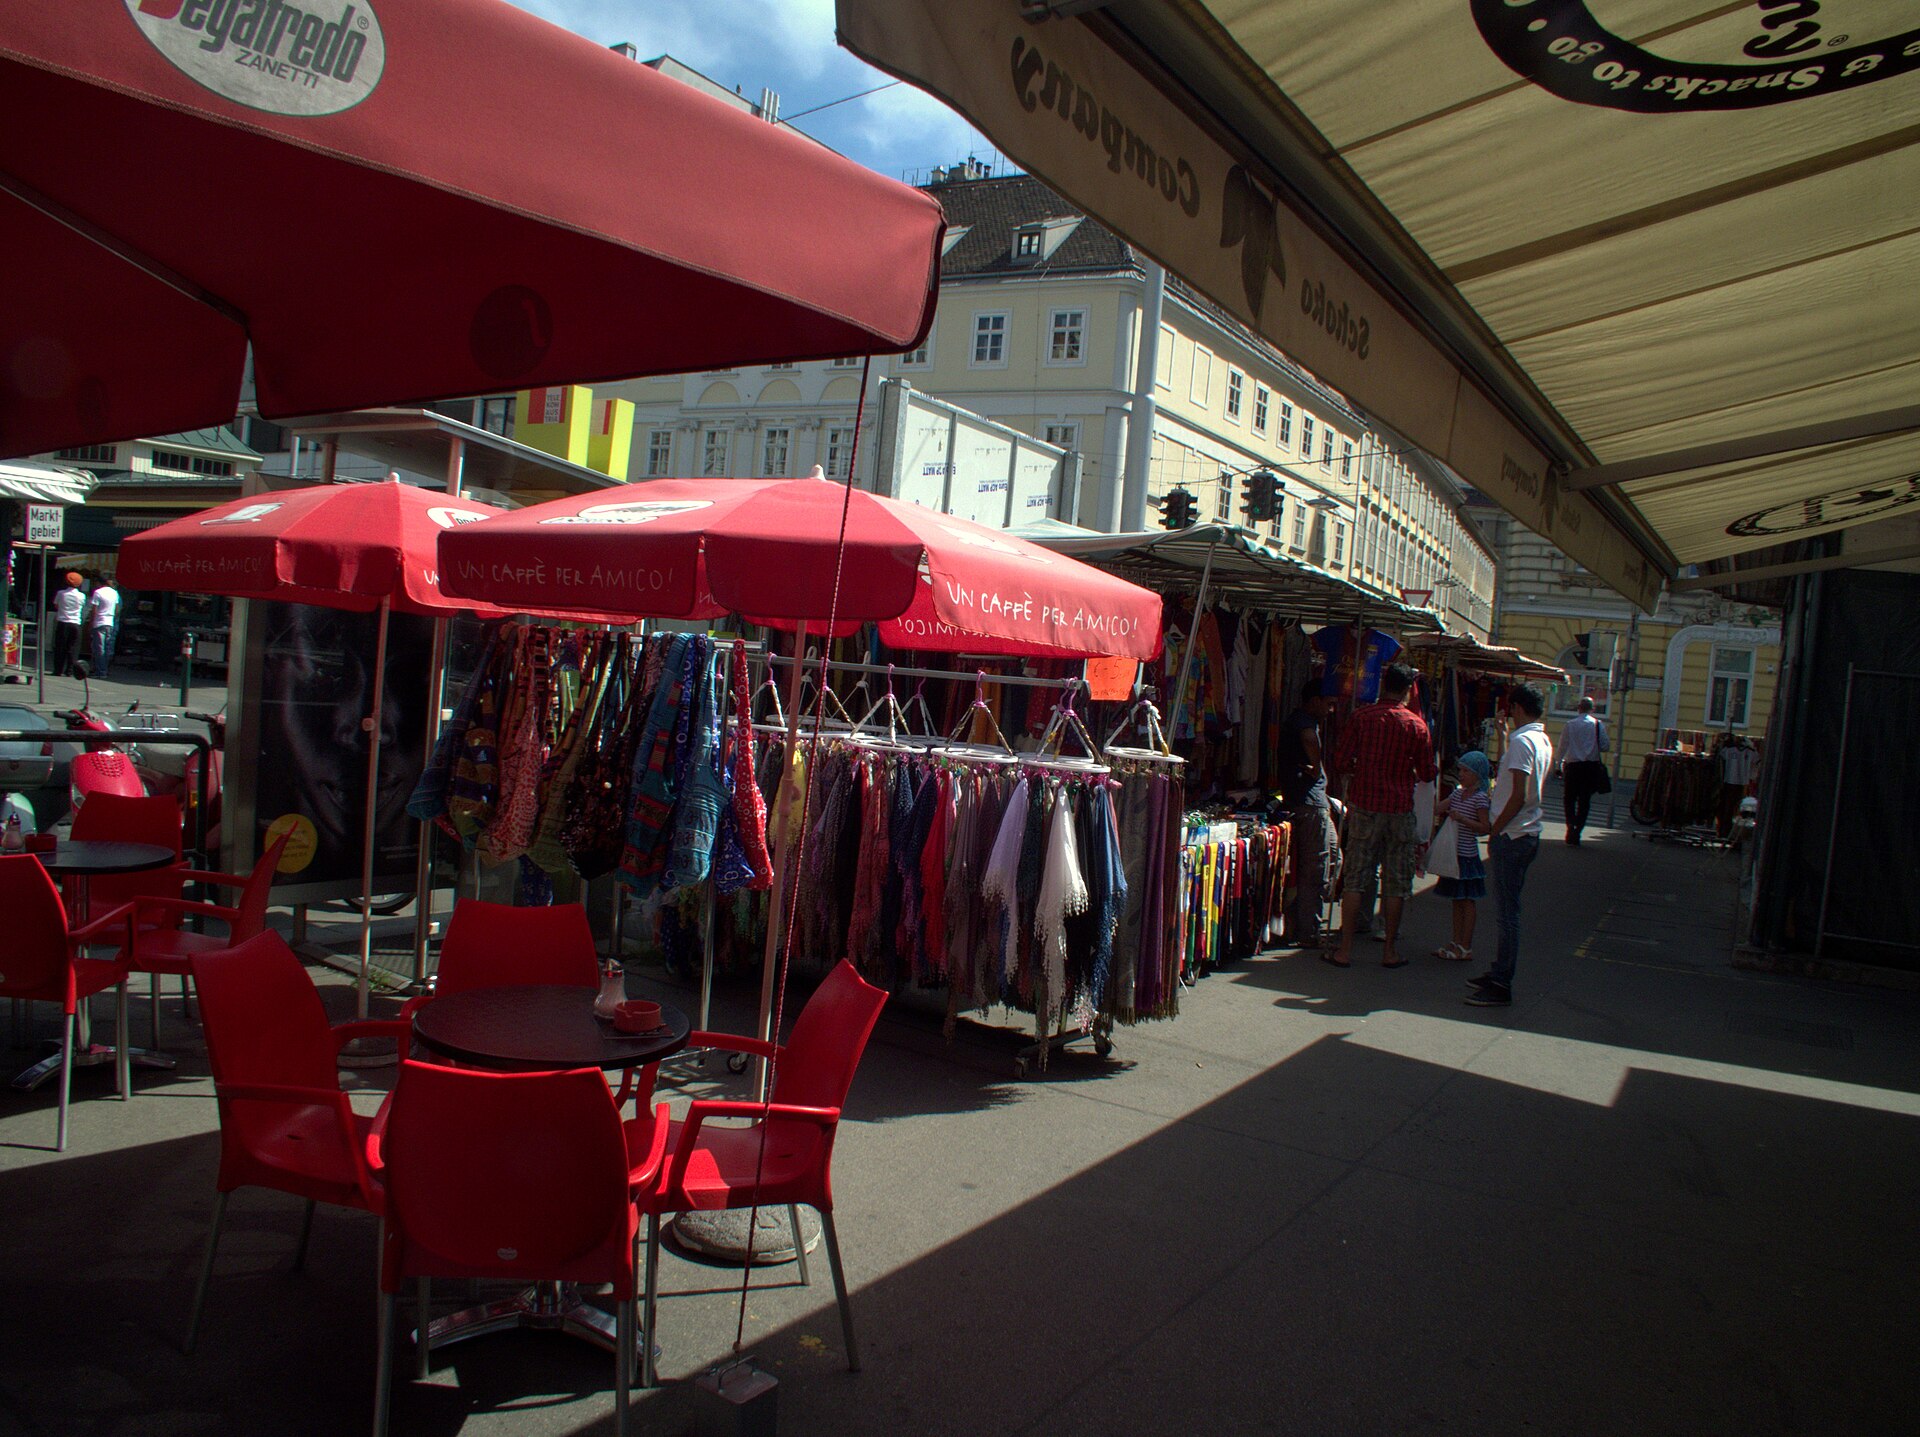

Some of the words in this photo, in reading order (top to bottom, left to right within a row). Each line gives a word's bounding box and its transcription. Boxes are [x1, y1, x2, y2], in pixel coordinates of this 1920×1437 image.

[1547, 36, 1605, 64] go
[235, 49, 320, 90] ZANETTI
[1592, 60, 1641, 90] to
[1643, 65, 1826, 100] Snacks
[31, 507, 62, 522] Markt-
[31, 525, 60, 540] gebiet
[139, 559, 156, 573] UN
[195, 559, 215, 572] PER
[457, 559, 485, 579] UN
[491, 556, 547, 585] CAFFÈ
[555, 567, 585, 586] PER
[589, 564, 674, 592] AMICO!
[946, 581, 975, 608] UN
[981, 591, 1034, 622] CAFFÈ
[1041, 605, 1069, 627] PER
[1072, 607, 1139, 639] AMICO!
